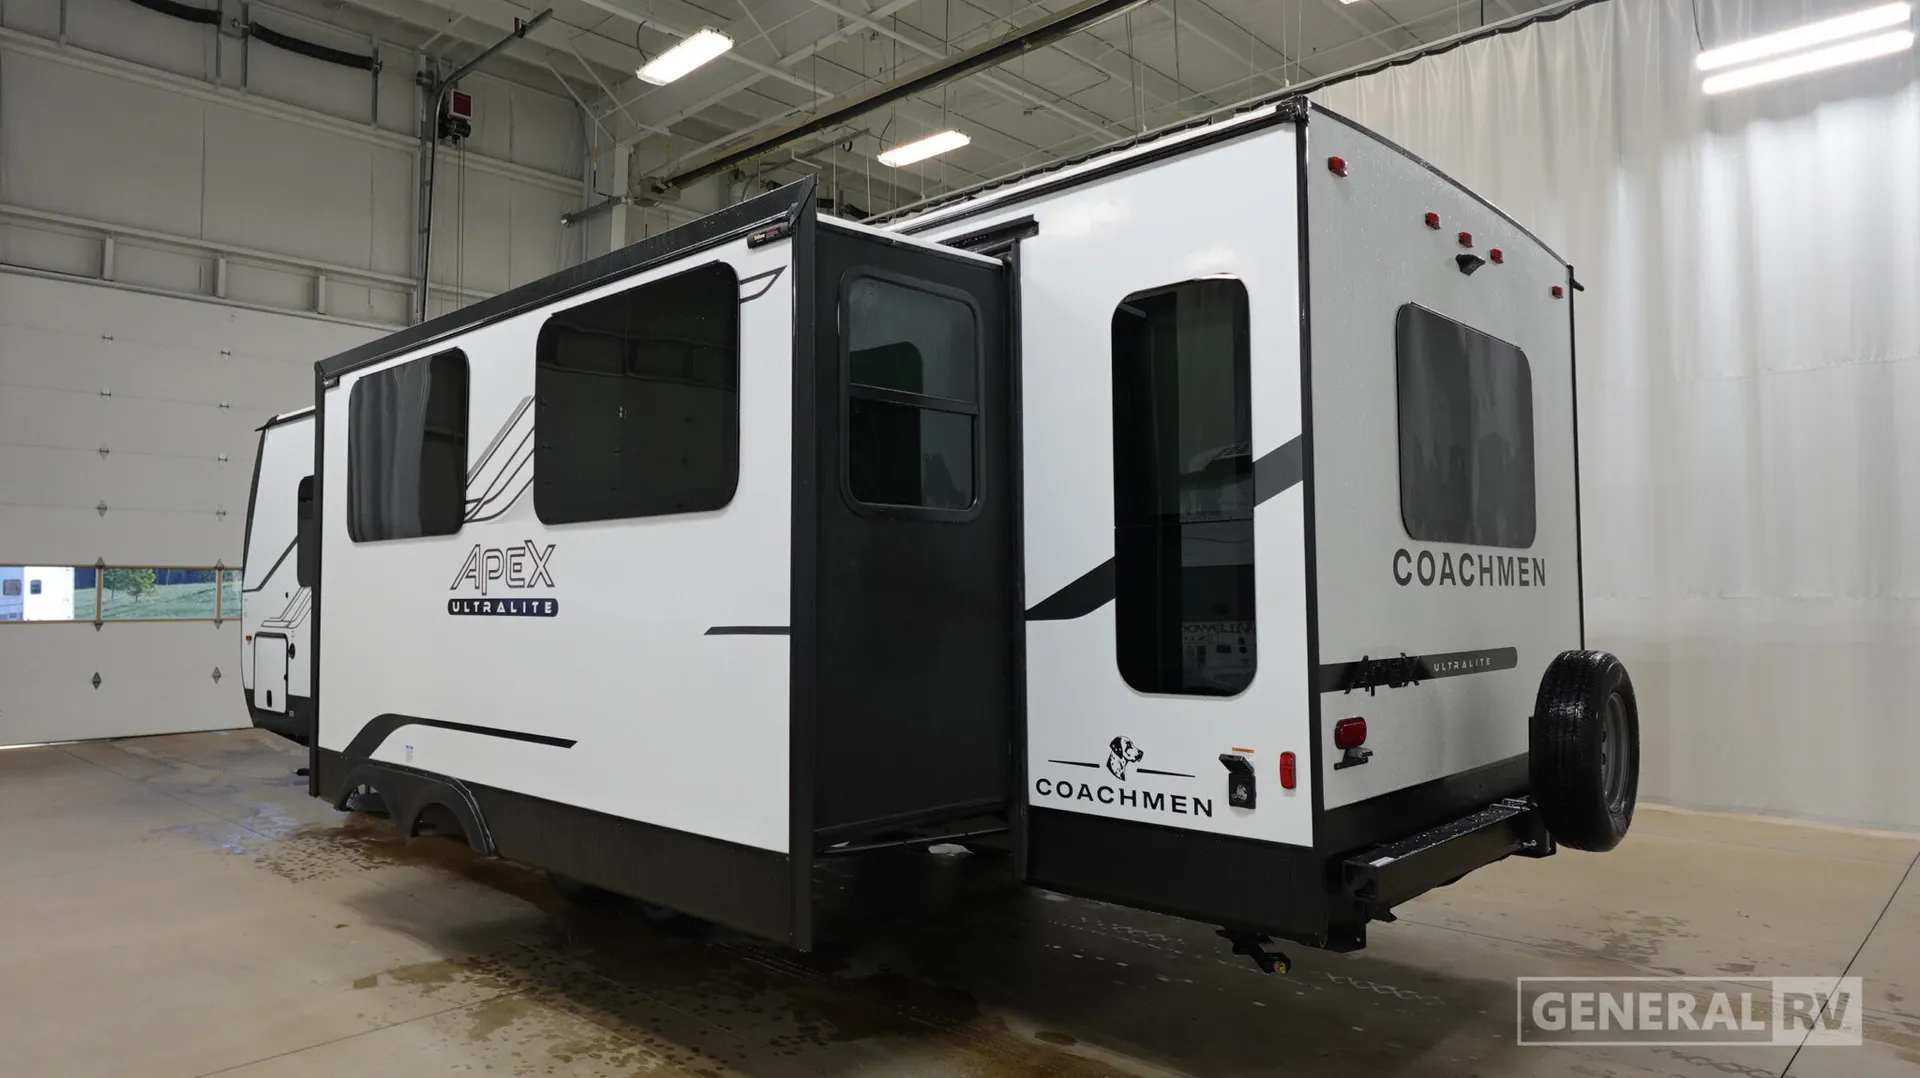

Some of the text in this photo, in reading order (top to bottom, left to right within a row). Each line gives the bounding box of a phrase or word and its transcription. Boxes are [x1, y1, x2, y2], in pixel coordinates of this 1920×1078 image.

[450, 539, 557, 596] APEX
[1393, 548, 1547, 587] COACHMEN
[452, 601, 553, 614] ULTRALITE
[1433, 656, 1492, 672] ULTRALITE
[1036, 778, 1213, 818] COACHMEN
